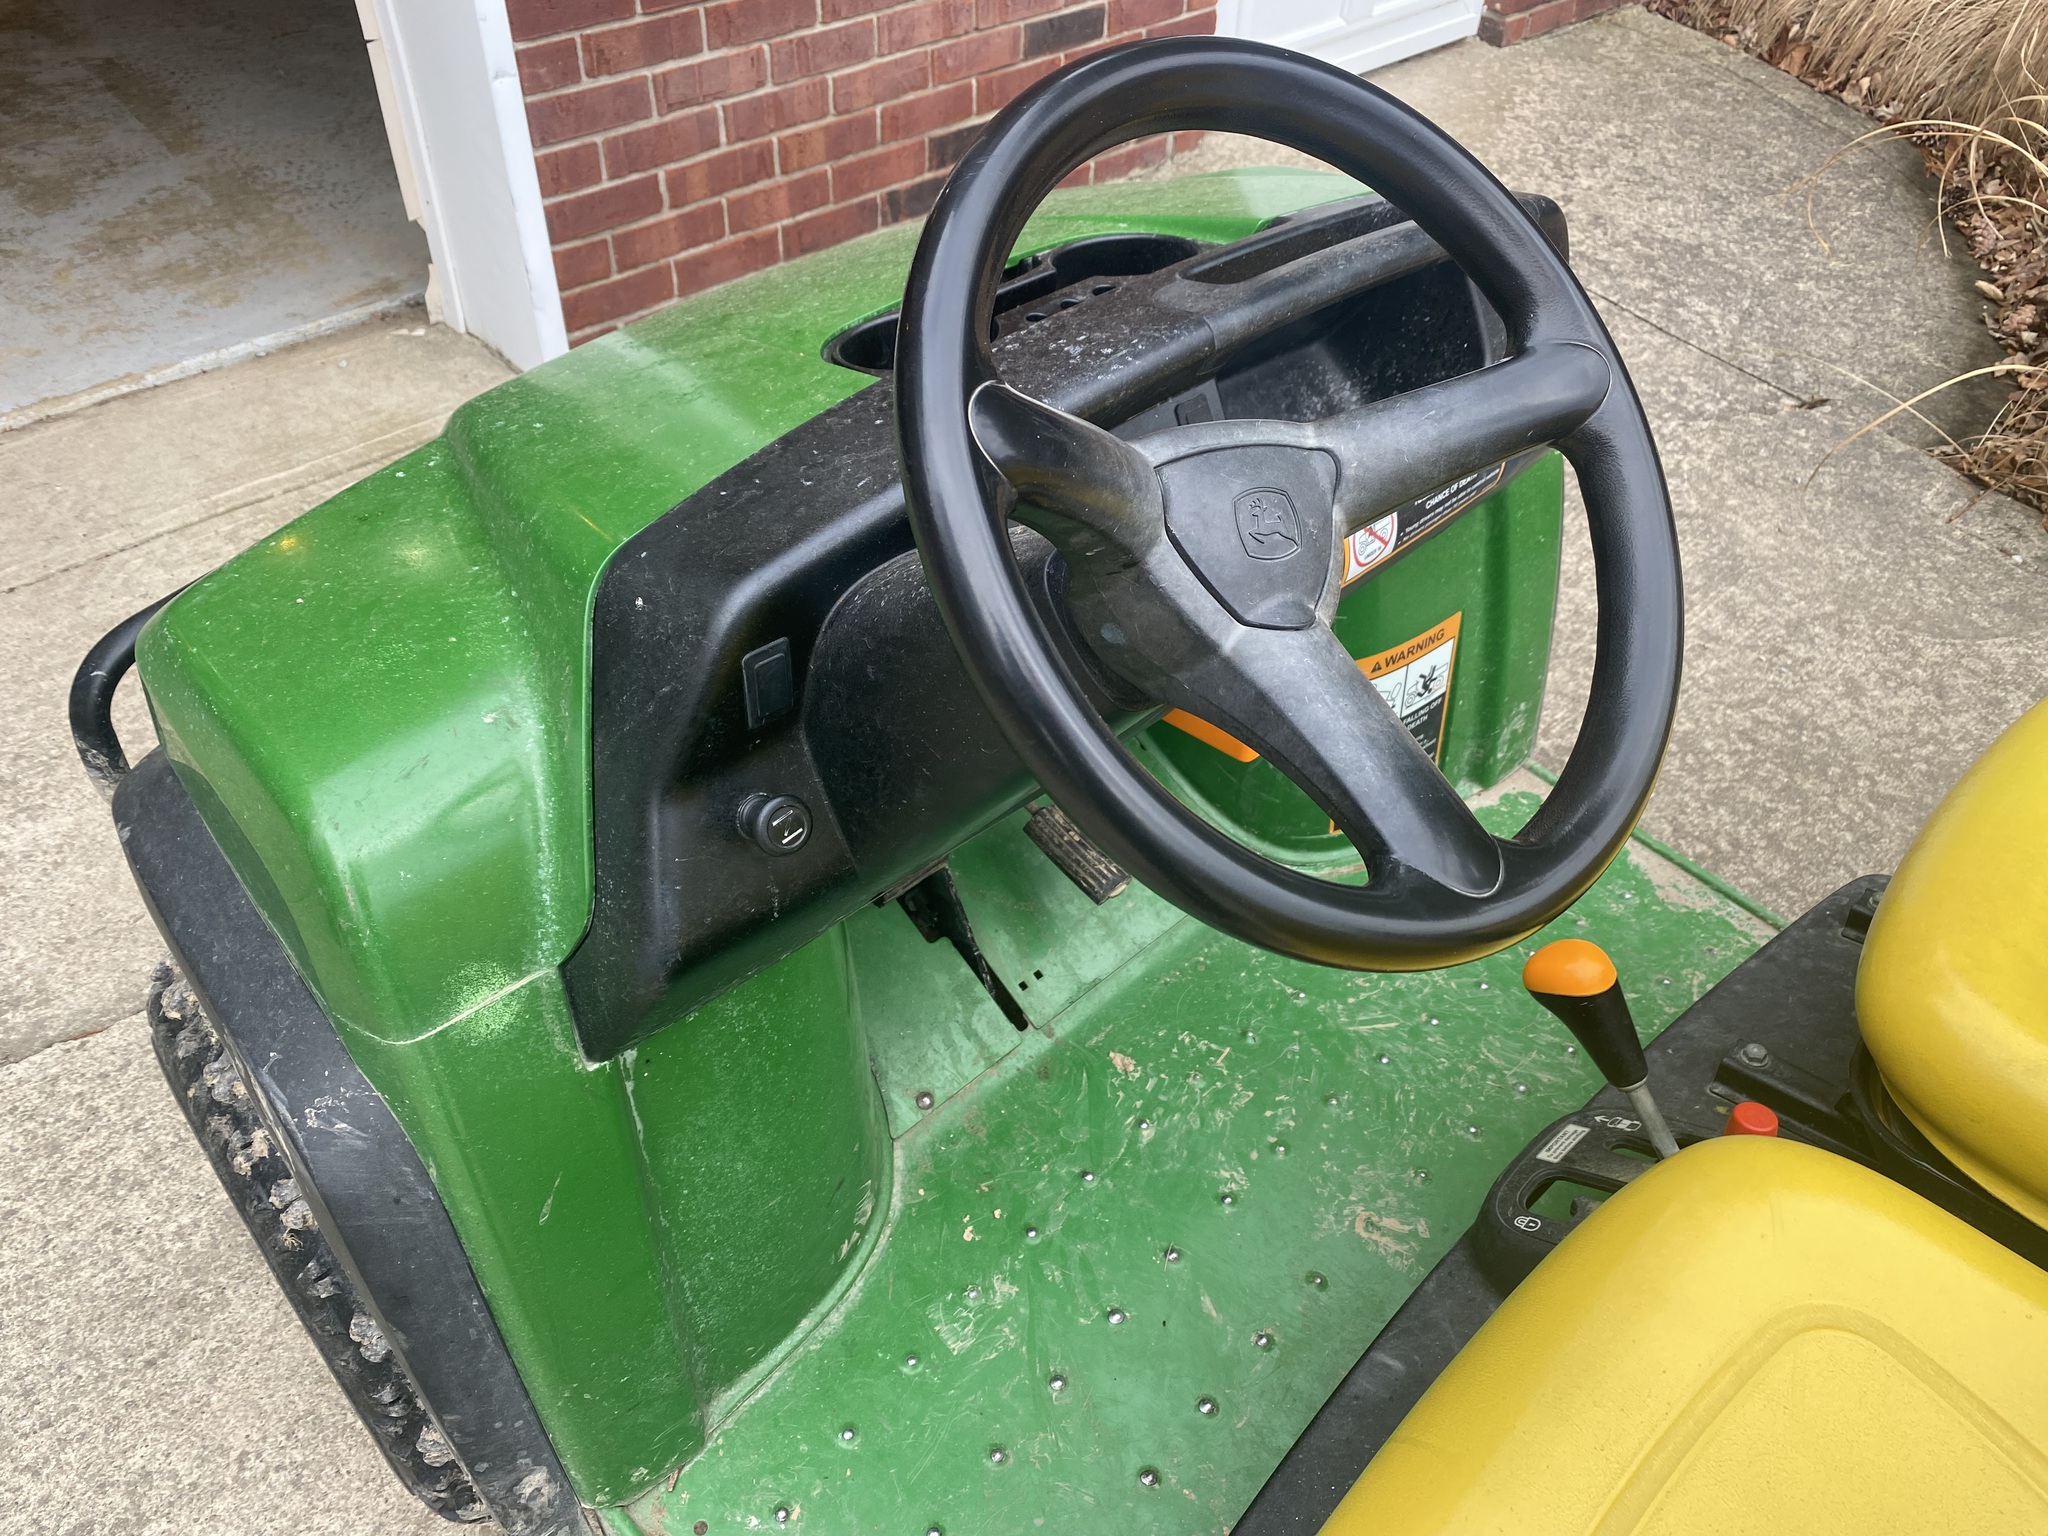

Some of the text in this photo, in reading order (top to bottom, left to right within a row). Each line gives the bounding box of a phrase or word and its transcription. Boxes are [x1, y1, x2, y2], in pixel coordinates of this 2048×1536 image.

[1426, 487, 1450, 509] CHANCE
[1450, 482, 1458, 493] OF
[1385, 628, 1445, 667] WARNING
[1403, 697, 1442, 724] FALLING OFF
[1408, 714, 1428, 730] DEATH
[1545, 1130, 1570, 1152] IMPORTANT
